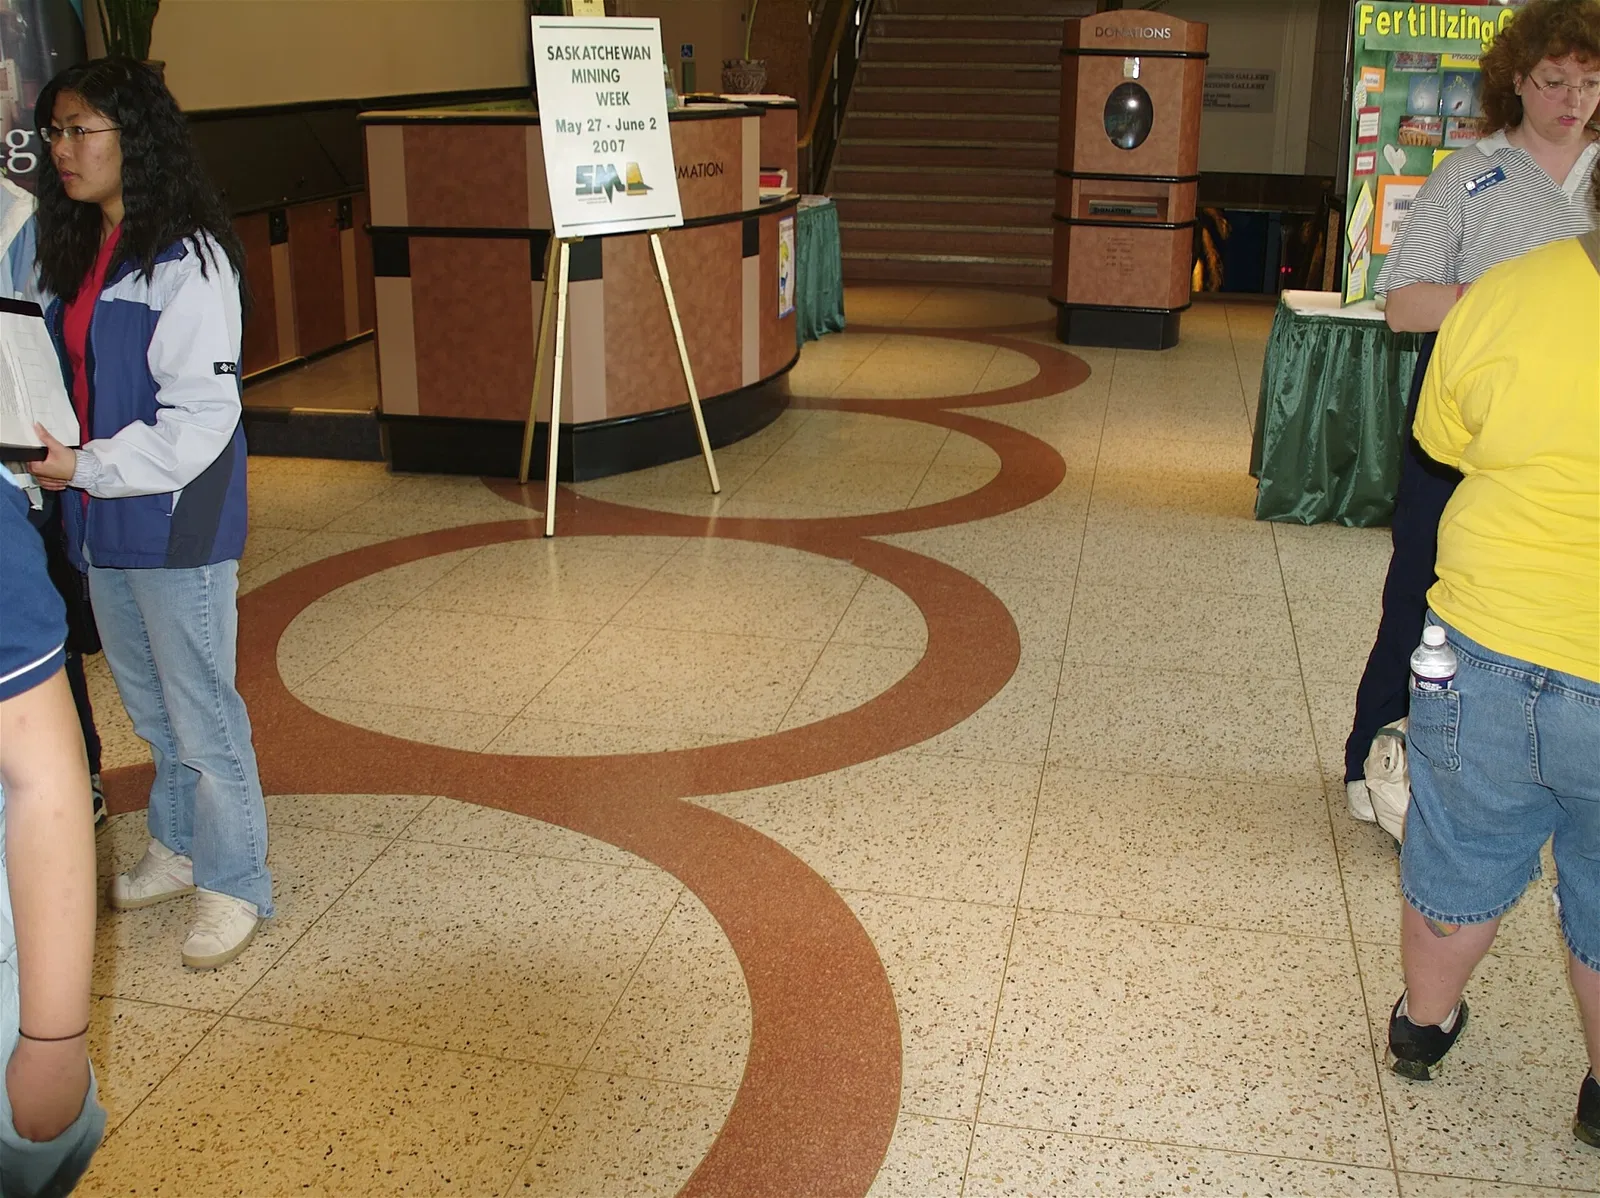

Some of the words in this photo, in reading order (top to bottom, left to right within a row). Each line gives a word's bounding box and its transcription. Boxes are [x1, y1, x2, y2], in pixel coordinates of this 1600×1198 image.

[1095, 26, 1171, 39] DONATIONS
[1359, 4, 1494, 51] Fertilizing
[547, 45, 651, 61] SASKATCHEWAN
[571, 68, 621, 84] MINING
[595, 91, 630, 106] WEEK
[555, 119, 582, 135] May
[587, 118, 601, 132] 27
[615, 118, 645, 131] June
[650, 117, 657, 130] 2
[593, 139, 626, 153] 2007
